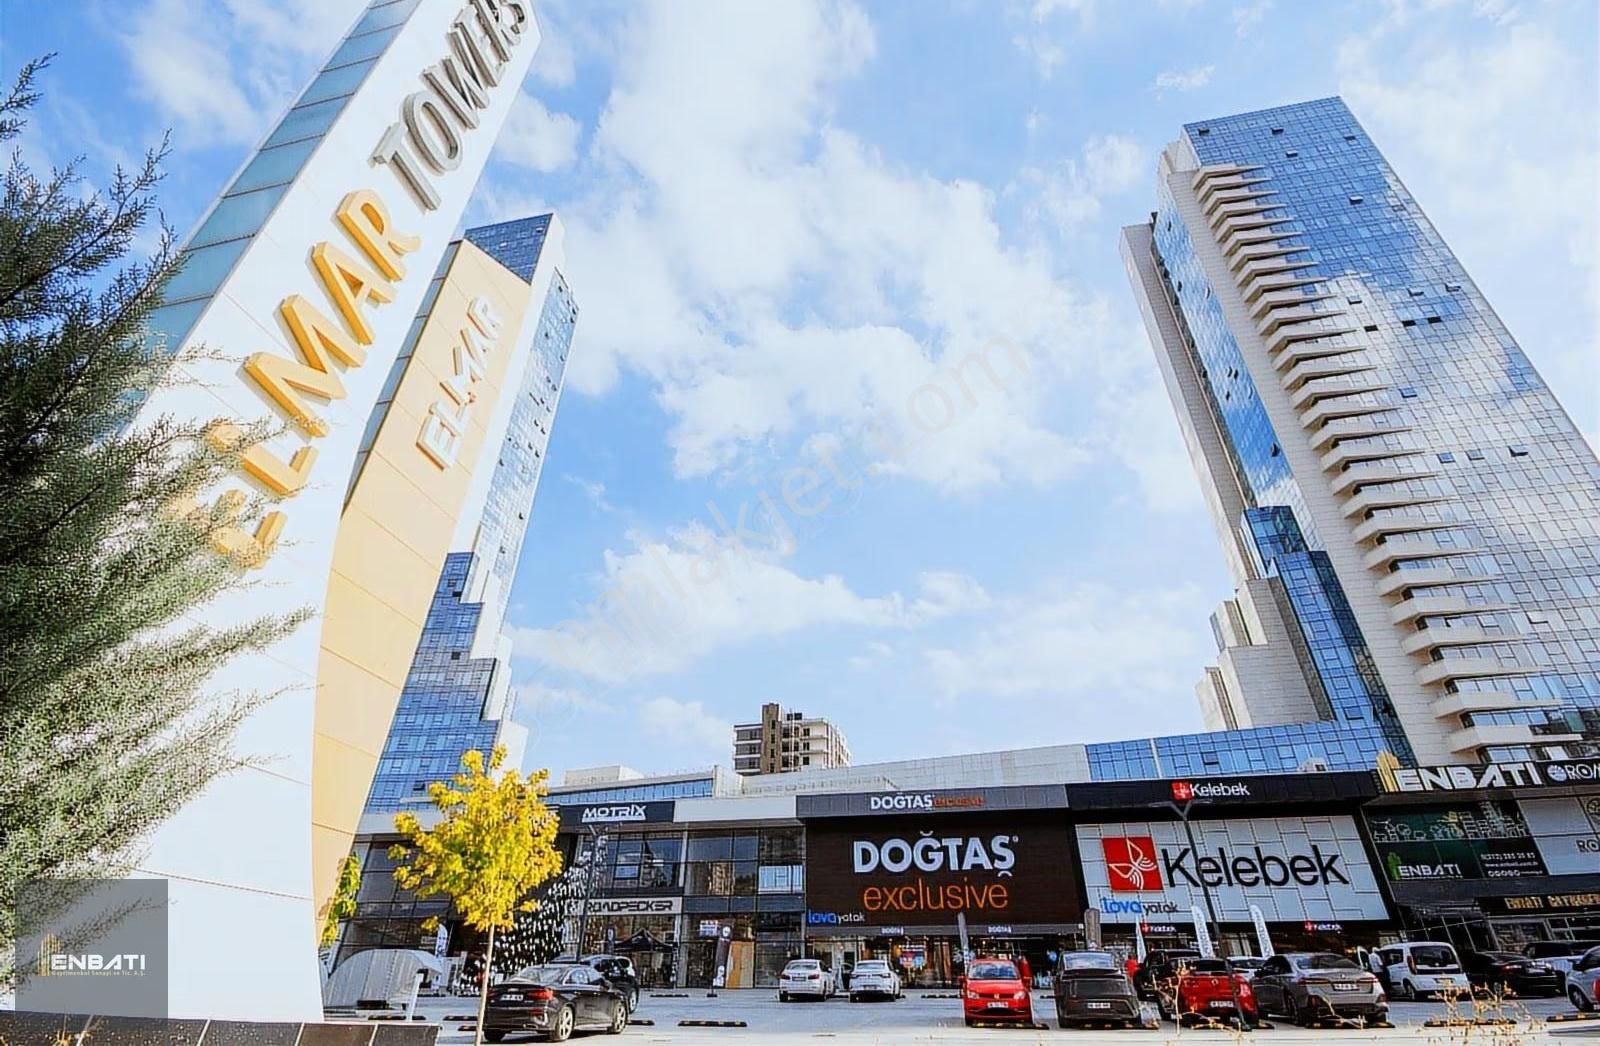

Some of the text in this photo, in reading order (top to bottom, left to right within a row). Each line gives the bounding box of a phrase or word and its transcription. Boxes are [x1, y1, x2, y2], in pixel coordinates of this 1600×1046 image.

[415, 294, 503, 472] ELMAR
[1190, 782, 1250, 797] Kelebek
[1393, 761, 1543, 792] ENBATI
[581, 804, 647, 822] MOTRIX
[853, 830, 1015, 877] DOĞTAŞ
[1161, 845, 1349, 888] Kelebek
[1398, 864, 1461, 877] ENBATI
[864, 877, 1008, 912] exclusive
